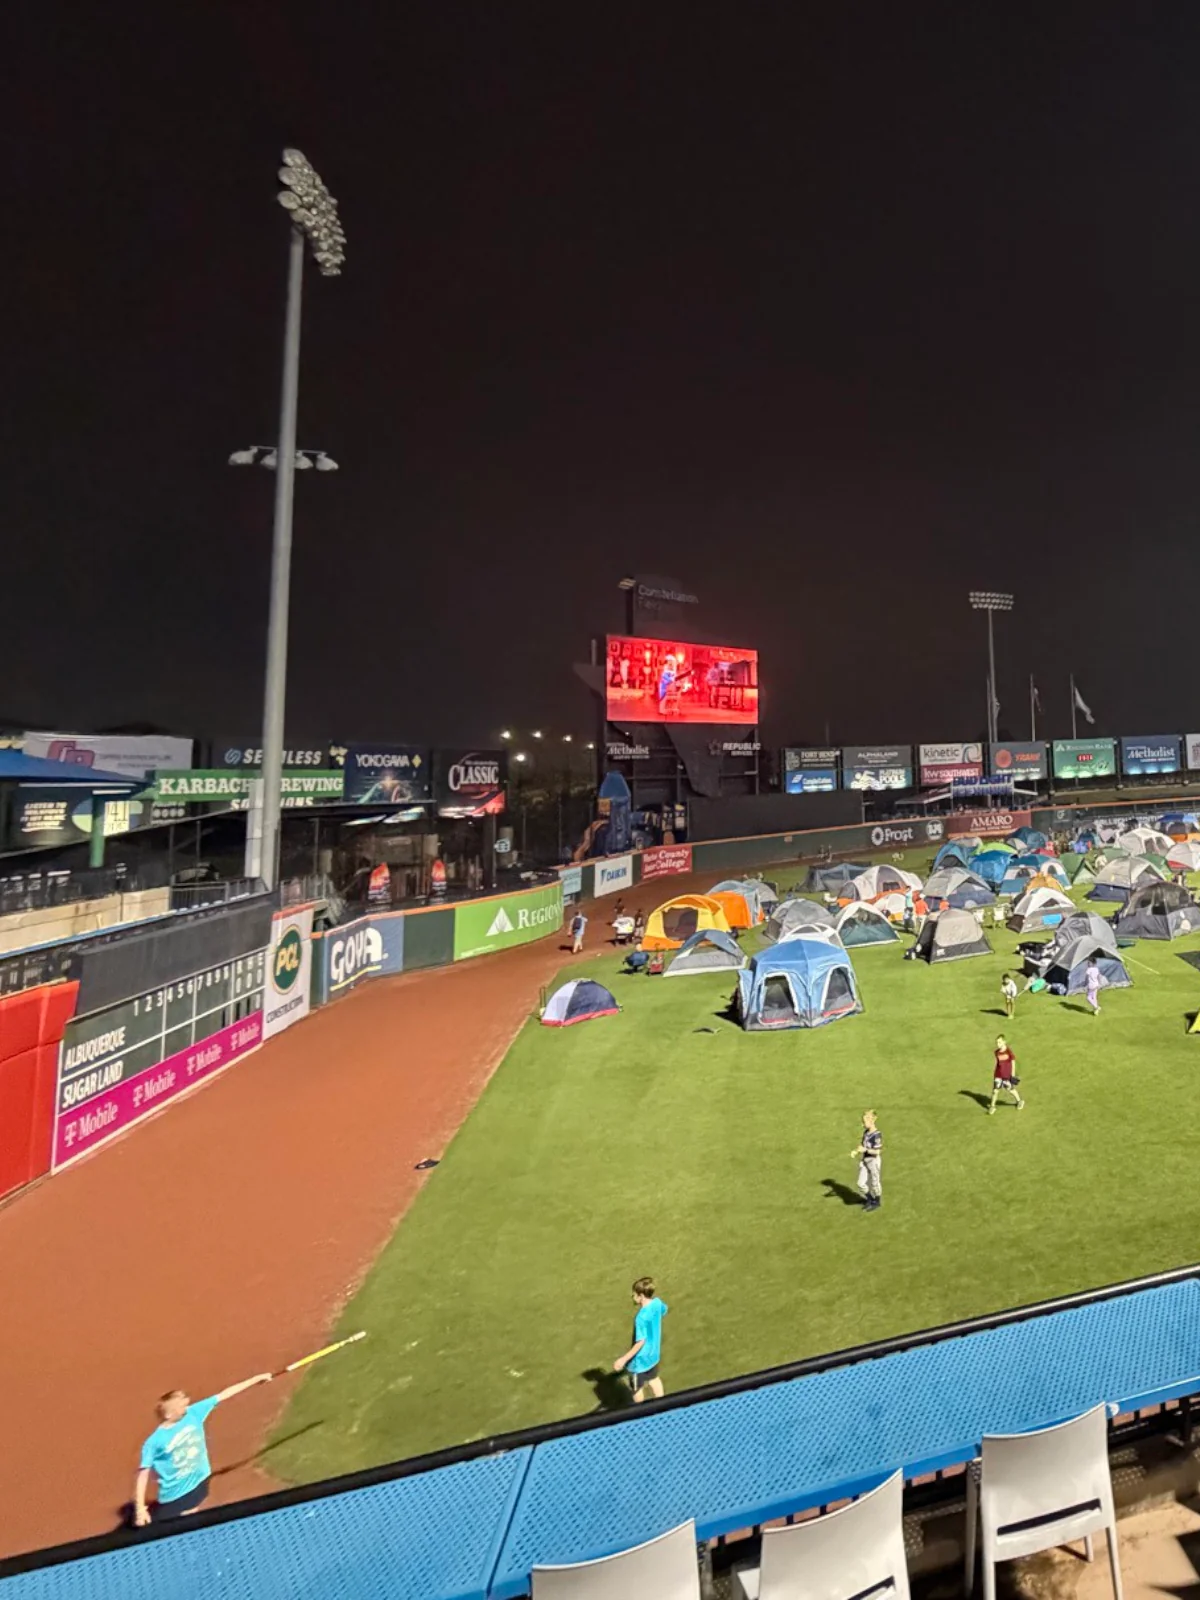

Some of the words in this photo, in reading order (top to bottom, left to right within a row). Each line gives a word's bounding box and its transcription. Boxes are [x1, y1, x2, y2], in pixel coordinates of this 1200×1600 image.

[723, 743, 761, 751] REPUBLIC
[923, 748, 960, 758] kinetic
[1127, 747, 1176, 759] Methodist
[243, 749, 322, 765] SELESS
[356, 754, 410, 768] YOKOGAWA
[280, 778, 344, 792] REWING
[448, 765, 499, 791] CLASSIC
[880, 775, 905, 785] POOLS
[970, 815, 1013, 827] AMARO
[884, 828, 914, 842] Frost
[659, 849, 690, 859] County
[275, 943, 299, 977] PCL
[331, 927, 383, 983] GOYA
[145, 994, 152, 1012] 2
[157, 991, 163, 1007] 3
[167, 987, 173, 1002] 4
[177, 983, 184, 999] 5
[187, 980, 193, 995] 6
[197, 975, 204, 991] 7
[64, 1026, 126, 1071] ALBUQUERQUE
[62, 1071, 99, 1109] SUGAR
[99, 1061, 124, 1090] LAND
